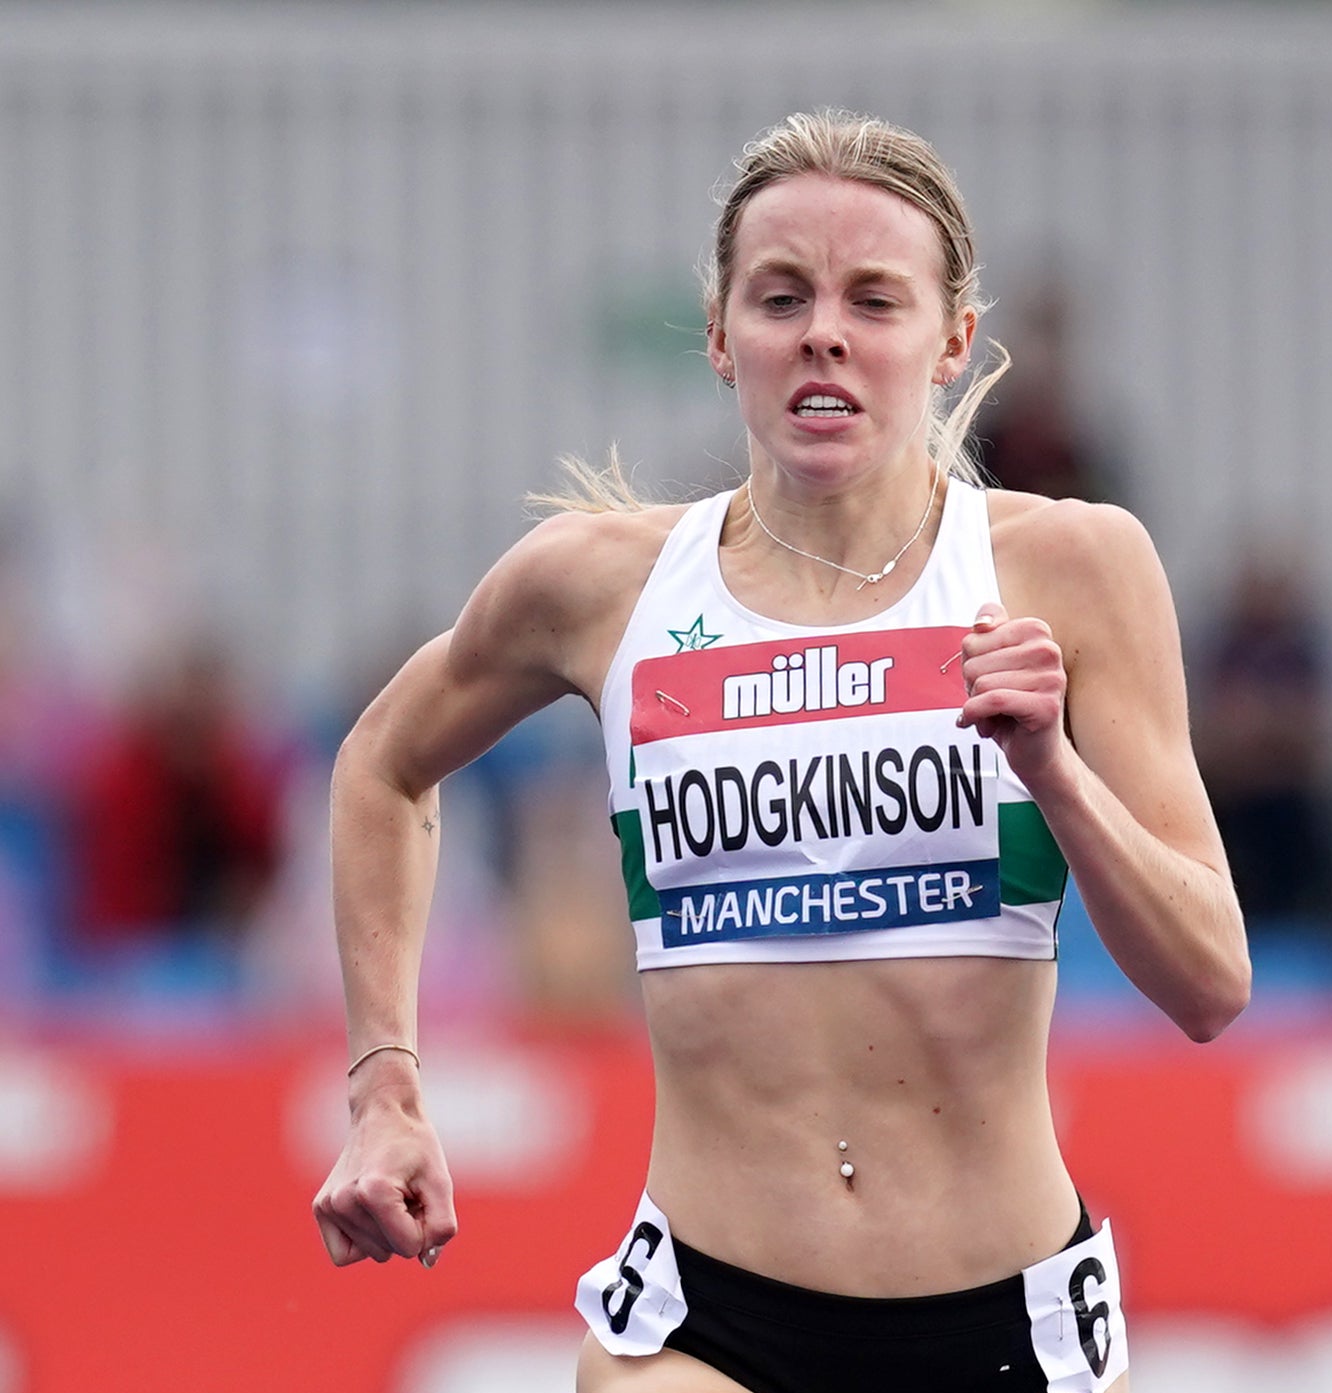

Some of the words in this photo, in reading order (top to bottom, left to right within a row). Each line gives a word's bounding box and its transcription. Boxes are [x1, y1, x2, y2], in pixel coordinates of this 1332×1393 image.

[722, 645, 895, 721] müller
[644, 744, 984, 863] HODGKINSON
[679, 869, 974, 936] MANCHESTER
[1068, 1257, 1112, 1379] 6
